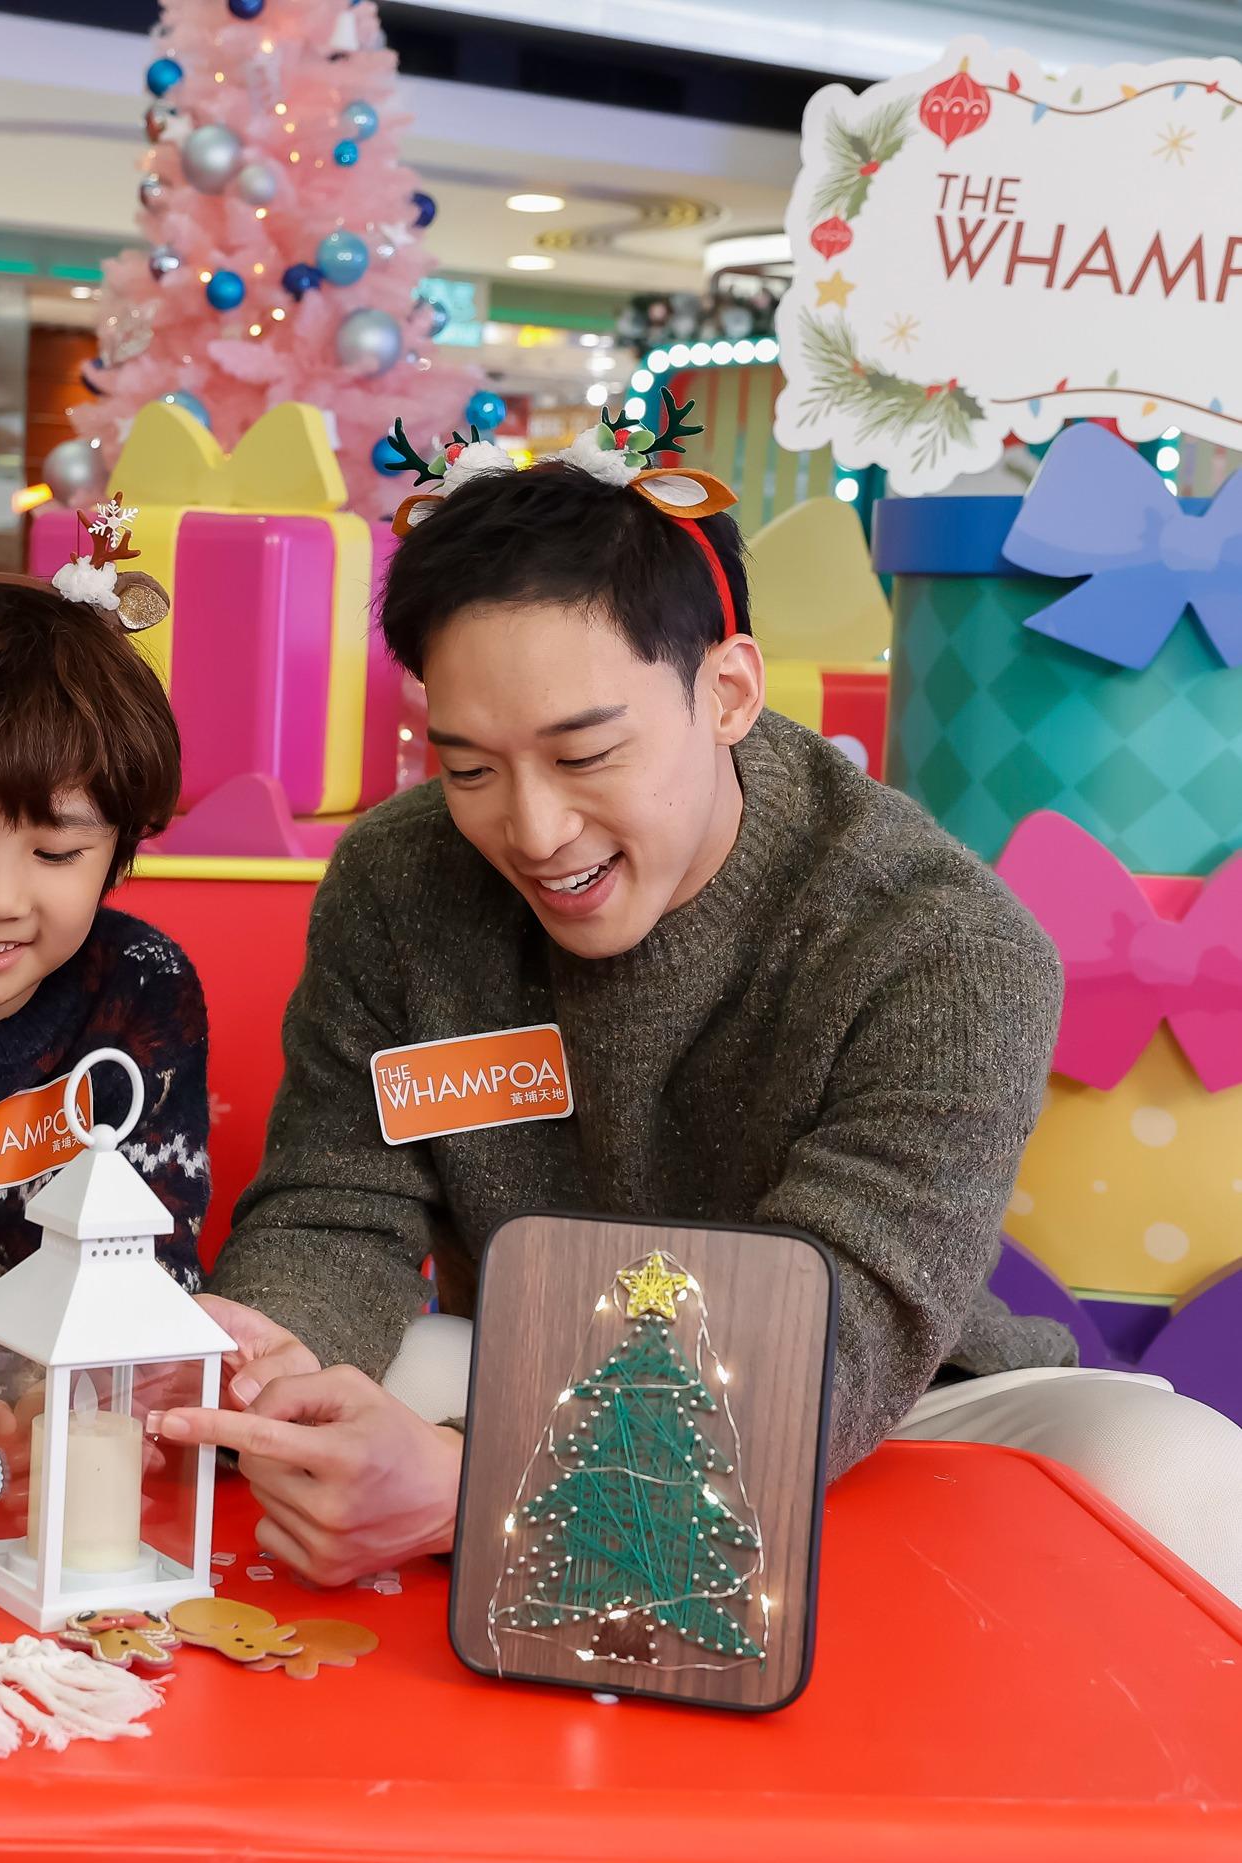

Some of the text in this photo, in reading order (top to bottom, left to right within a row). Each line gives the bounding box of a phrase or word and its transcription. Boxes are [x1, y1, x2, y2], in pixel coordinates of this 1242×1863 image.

[937, 172, 1022, 215] THE
[377, 1063, 412, 1086] THE
[382, 1058, 561, 1111] WHAMPOA
[51, 1133, 81, 1154] 黃埔天
